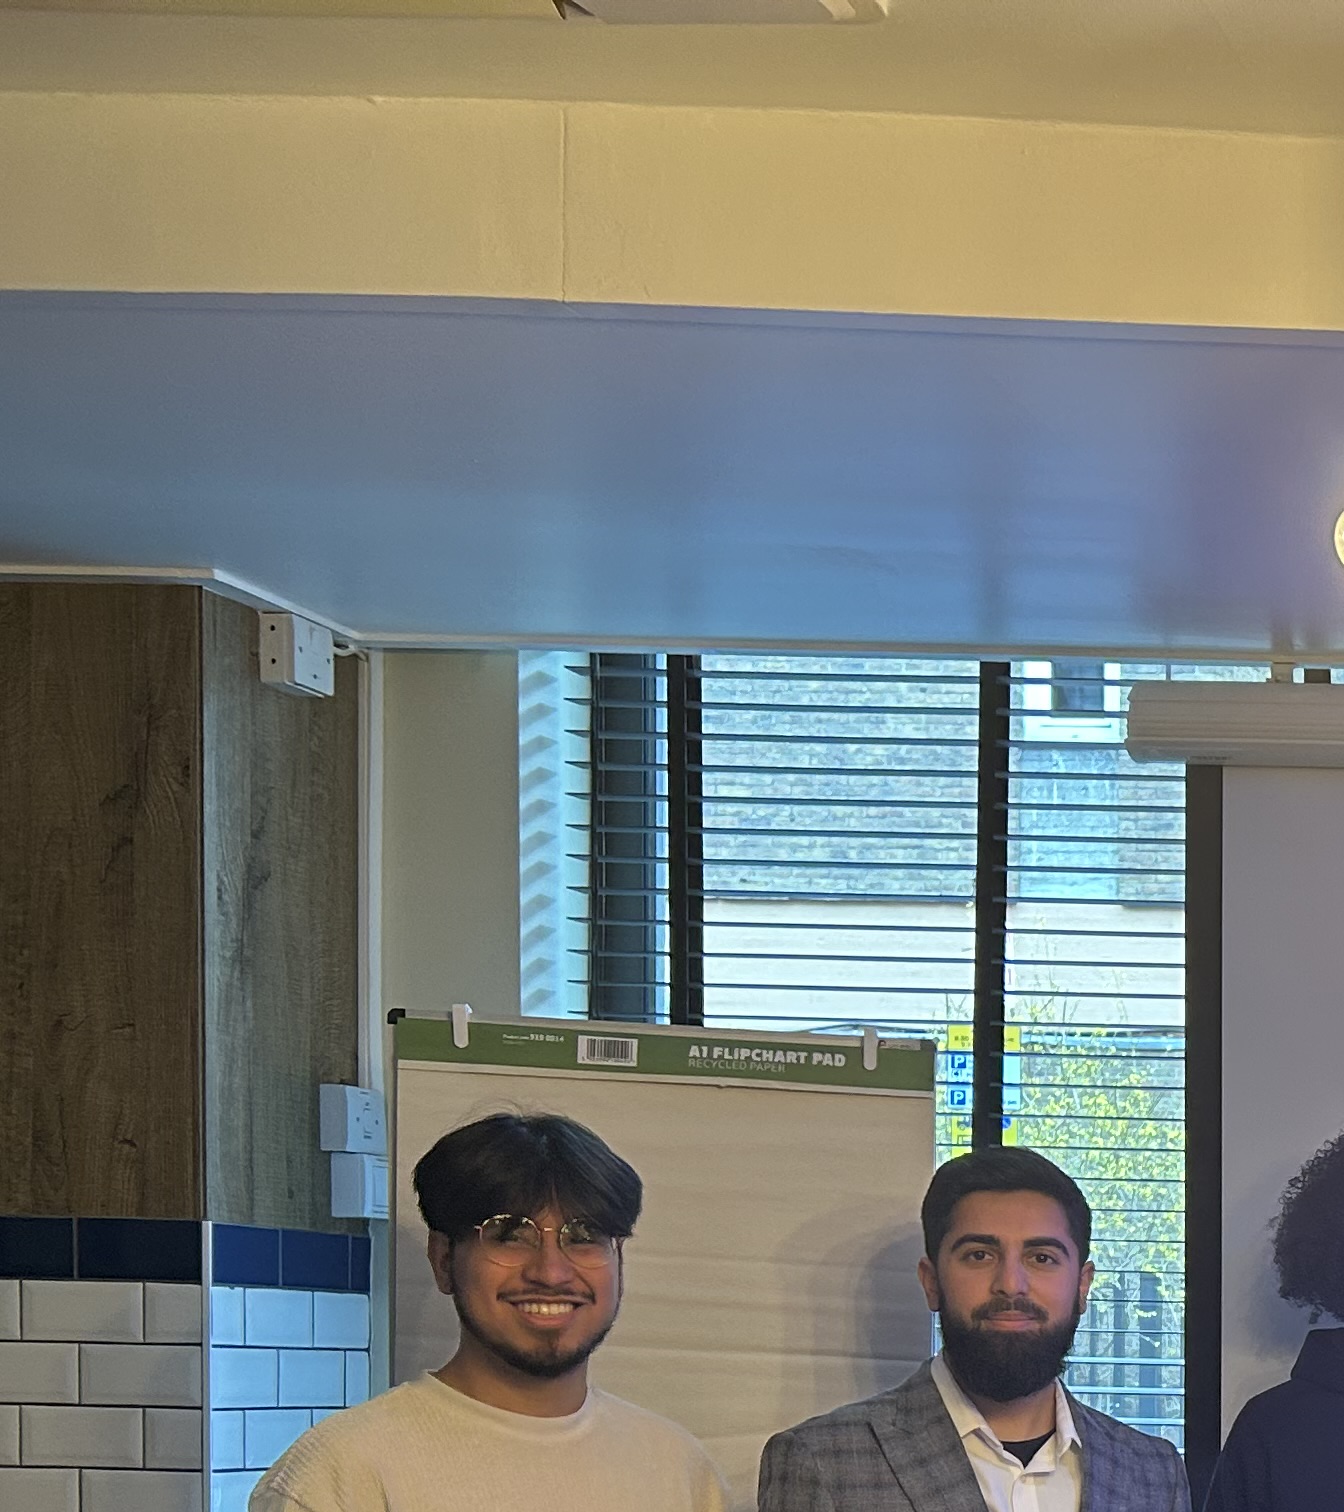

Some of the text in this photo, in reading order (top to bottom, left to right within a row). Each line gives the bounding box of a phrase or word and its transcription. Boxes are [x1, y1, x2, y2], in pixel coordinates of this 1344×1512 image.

[688, 1045, 847, 1067] A1 FLIPCHART PAD
[688, 1058, 787, 1073] RECYCLED PAPER
